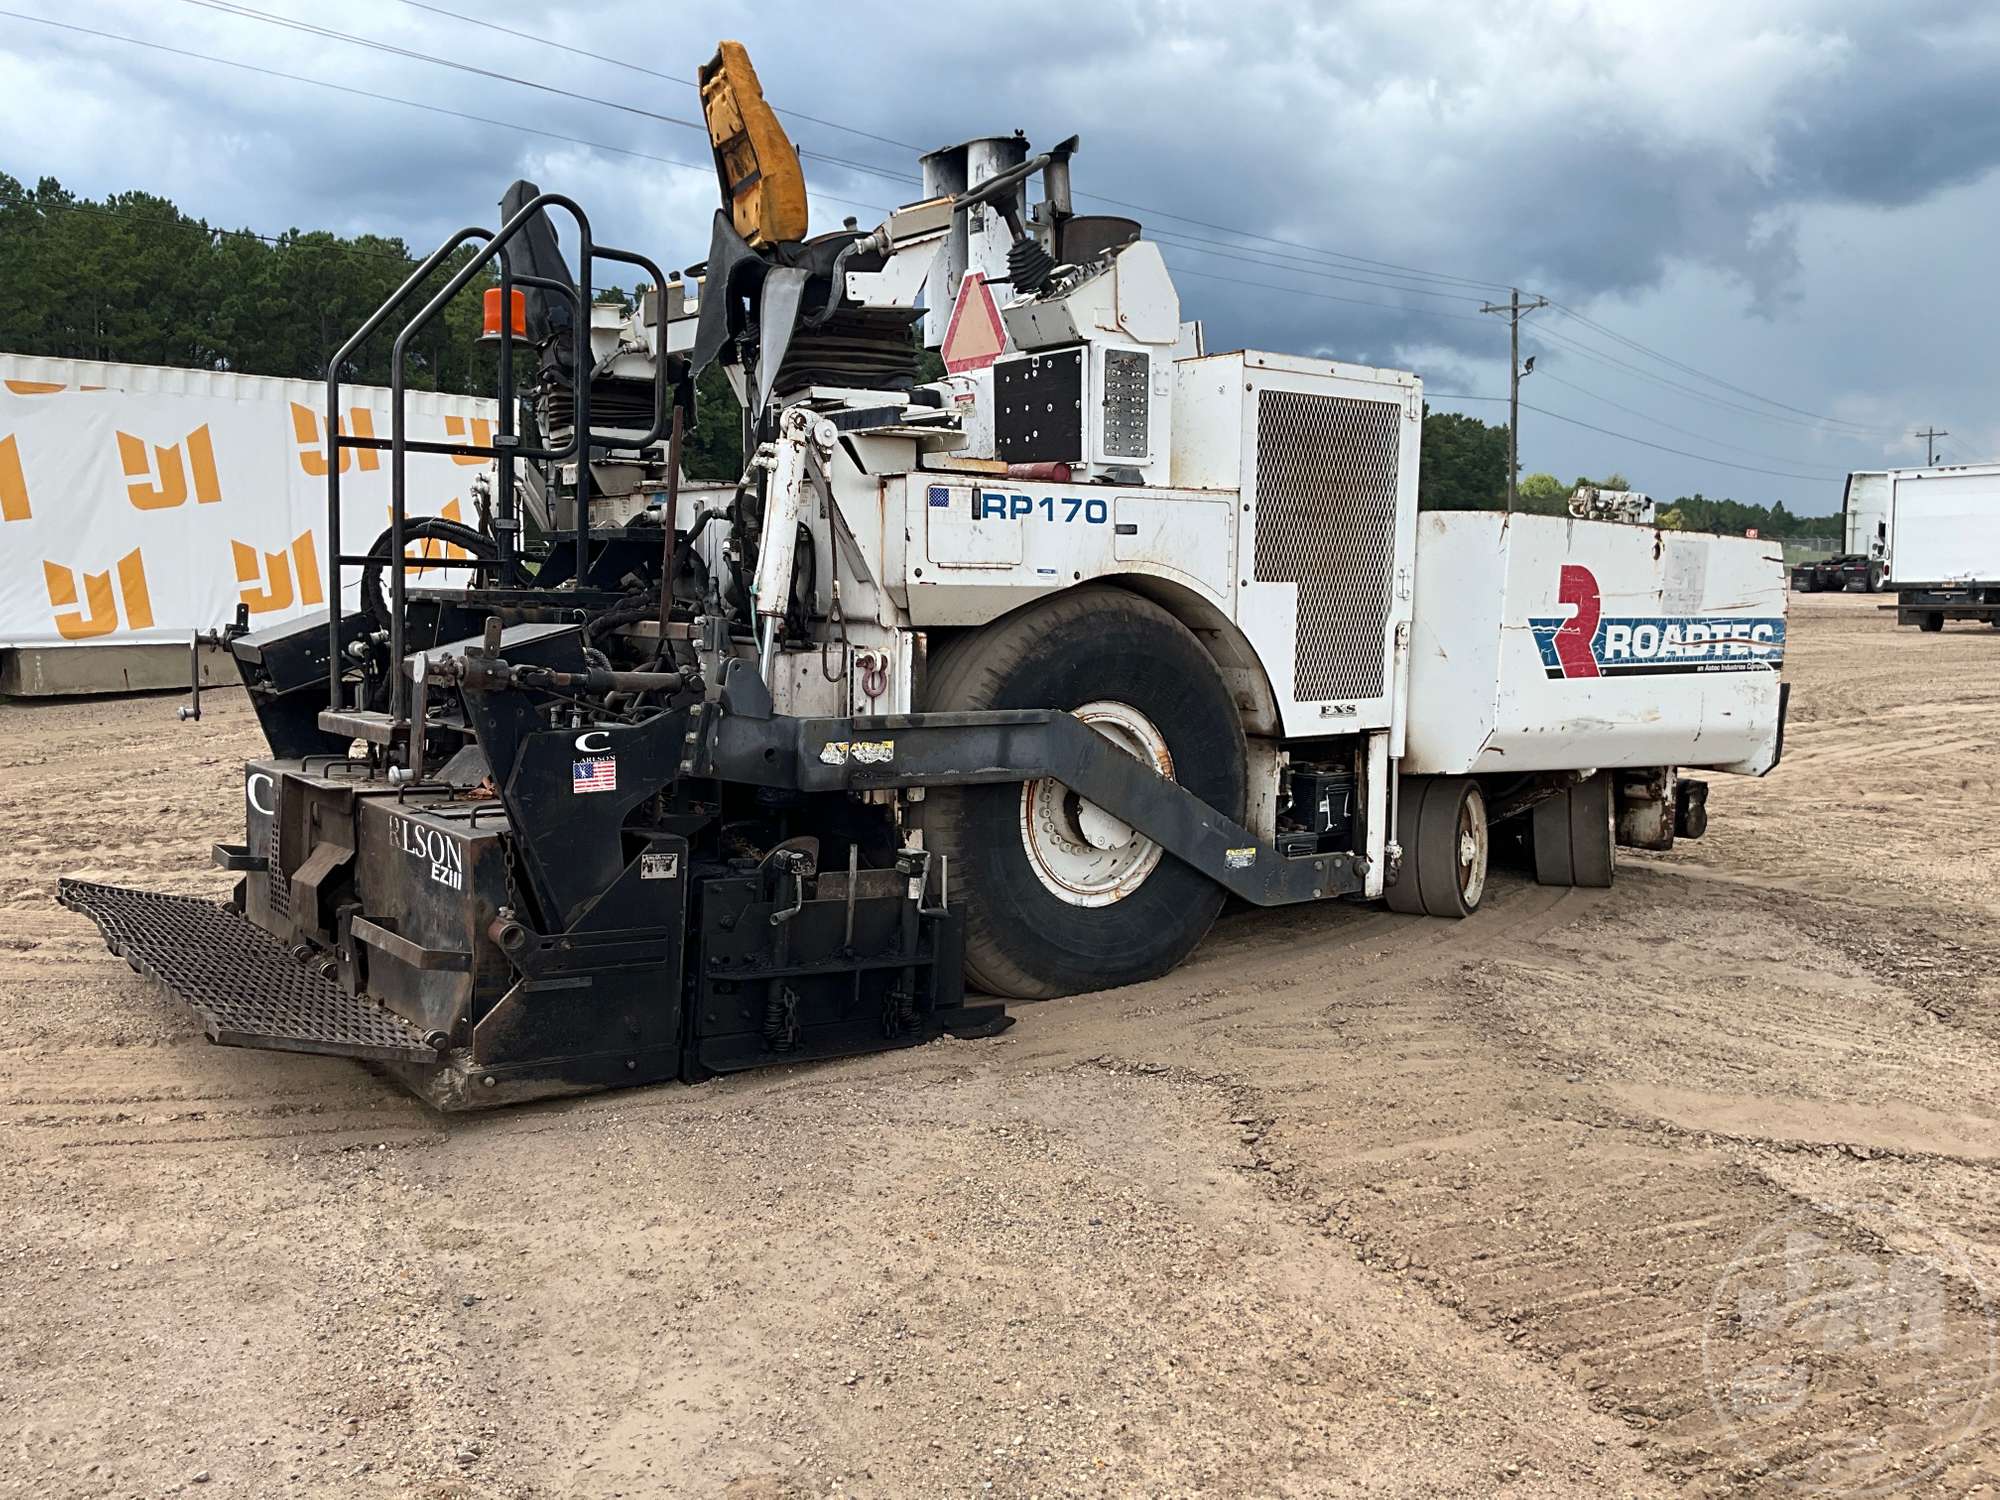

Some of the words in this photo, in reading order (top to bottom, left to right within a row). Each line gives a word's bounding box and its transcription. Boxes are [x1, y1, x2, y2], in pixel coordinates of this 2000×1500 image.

[982, 493, 1107, 524] RP170
[1604, 623, 1774, 659] ROADTEC
[431, 862, 462, 891] EZIII
